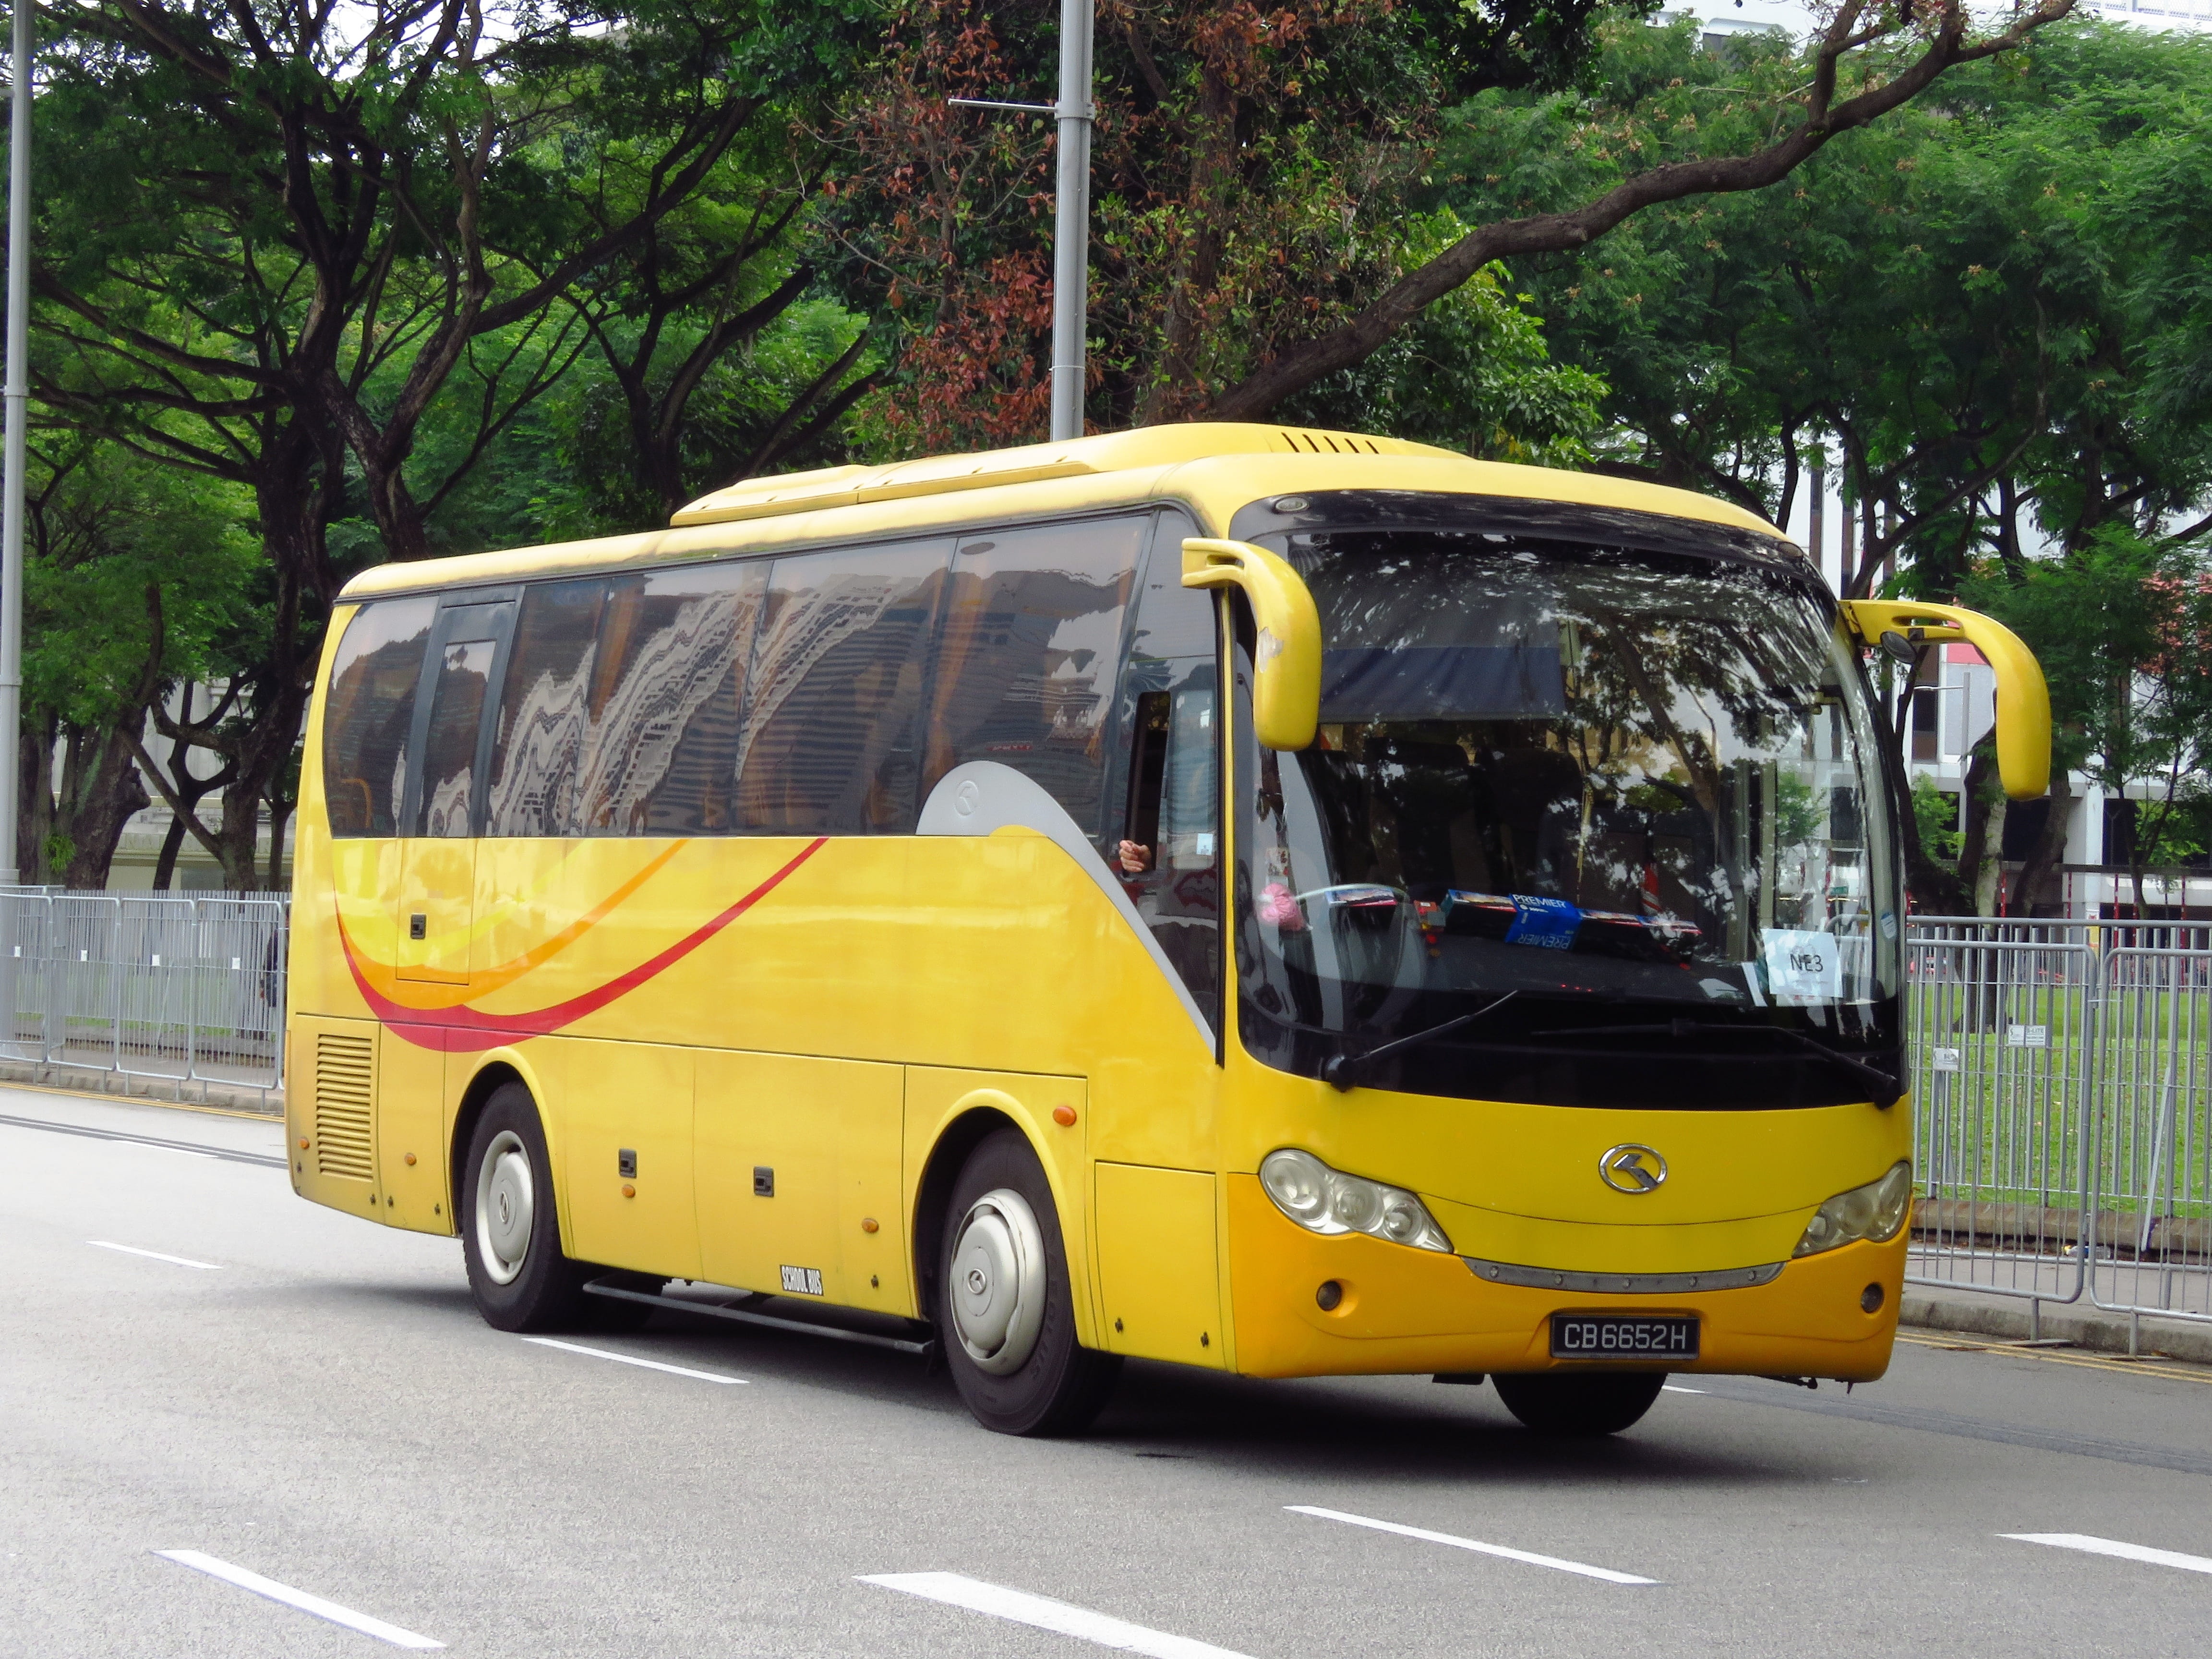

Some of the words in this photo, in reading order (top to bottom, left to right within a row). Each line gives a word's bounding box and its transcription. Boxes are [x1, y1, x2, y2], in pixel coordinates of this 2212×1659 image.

[1512, 894, 1566, 908] PREMIER
[1517, 933, 1571, 949] PREMIER
[1790, 953, 1823, 972] NE3
[781, 1266, 808, 1293] SCHOOL
[807, 1269, 822, 1295] BUS
[1564, 1323, 1686, 1350] CB6652H
